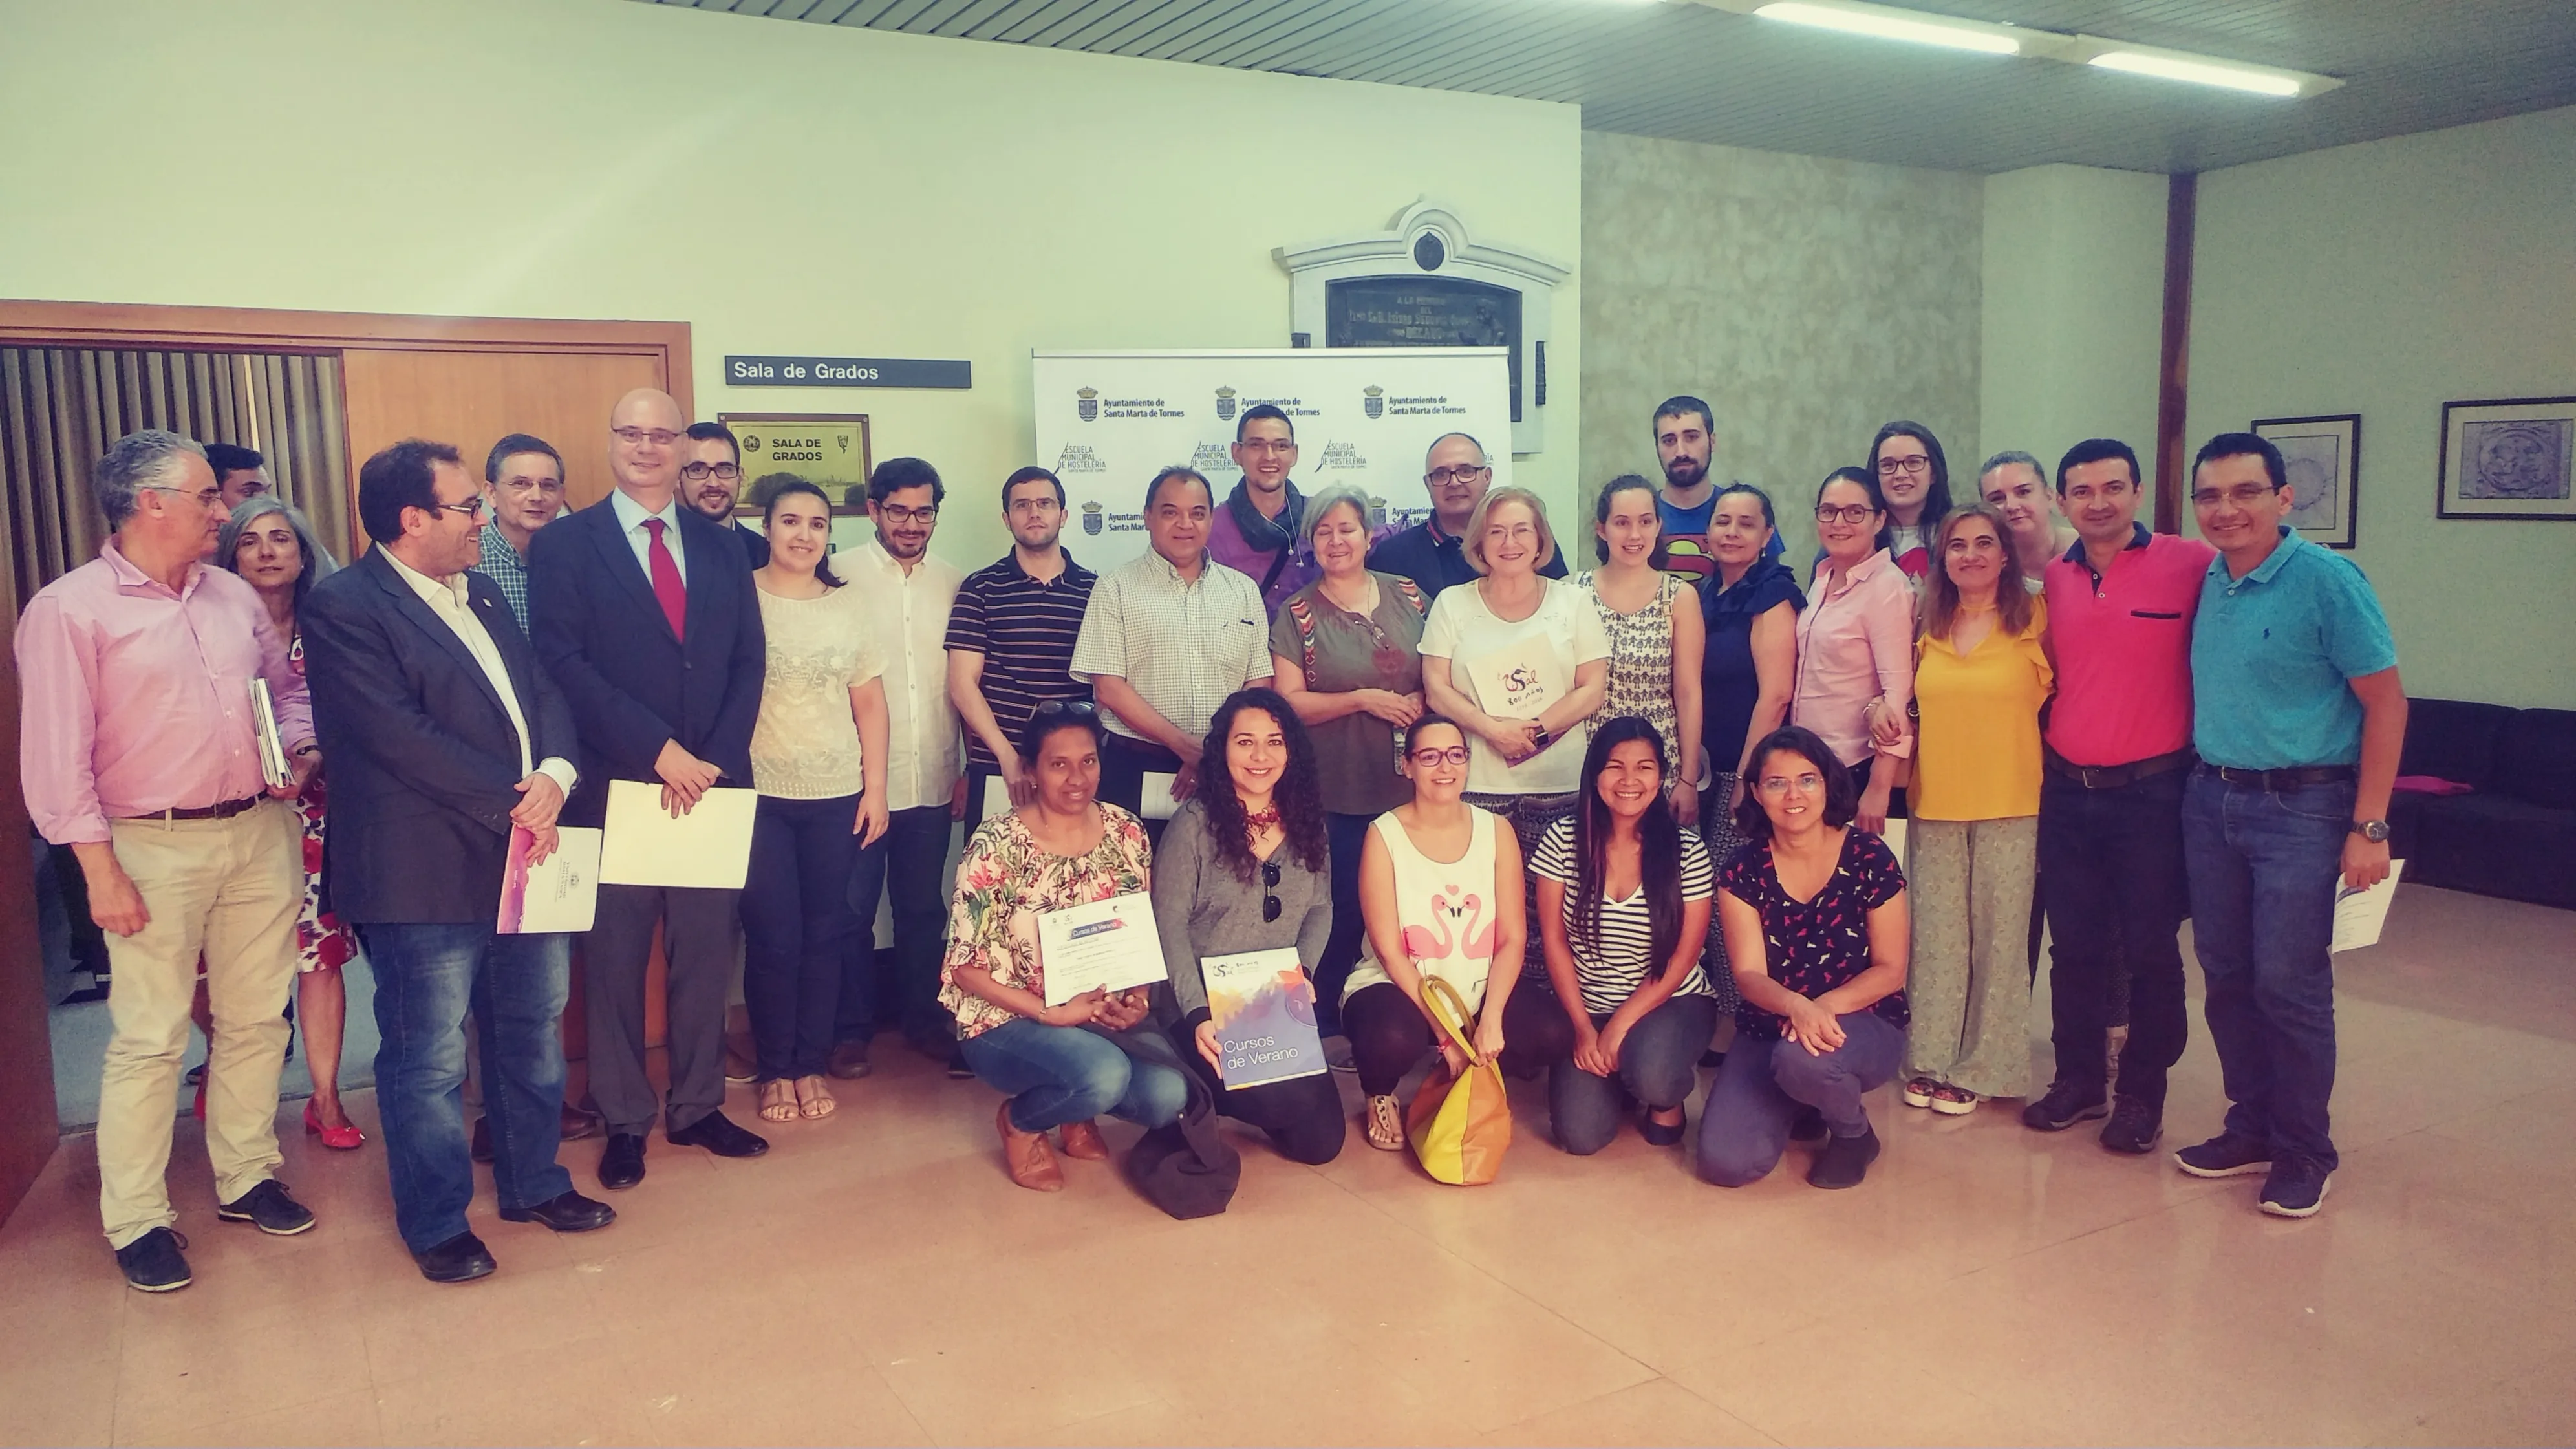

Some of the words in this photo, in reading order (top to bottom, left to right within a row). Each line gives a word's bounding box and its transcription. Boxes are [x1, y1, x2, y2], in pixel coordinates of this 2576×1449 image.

[734, 361, 774, 378] Sala
[783, 362, 806, 379] de
[815, 362, 879, 380] Grados
[1103, 398, 1155, 408] Ayuntamiento
[1155, 398, 1165, 407] de
[1293, 396, 1302, 405] de
[1388, 396, 1438, 406] Ayuntamiento
[1104, 409, 1125, 418] Santa
[1126, 409, 1148, 418] Marta
[1149, 409, 1158, 417] de
[1159, 409, 1185, 418] Tormes
[1285, 407, 1294, 416] de
[1295, 407, 1320, 416] Tormes
[1389, 407, 1408, 415] Santa
[1410, 407, 1431, 415] Marta
[1432, 406, 1441, 414] de
[1442, 405, 1466, 414] Tormes
[772, 438, 802, 448] SALA
[805, 438, 821, 448] DE
[772, 451, 822, 461] GRADOS
[1329, 455, 1367, 465] HOSTELERÍA
[1058, 460, 1066, 469] DE
[1068, 458, 1106, 469] HOSTELERÍA
[1108, 523, 1129, 531] Santa
[1507, 696, 1522, 706] 800
[1071, 927, 1090, 937] Cursos
[1098, 922, 1117, 932] Verano
[1223, 1035, 1275, 1054] Cursos
[1227, 1056, 1246, 1069] de
[1249, 1047, 1299, 1065] Verano
